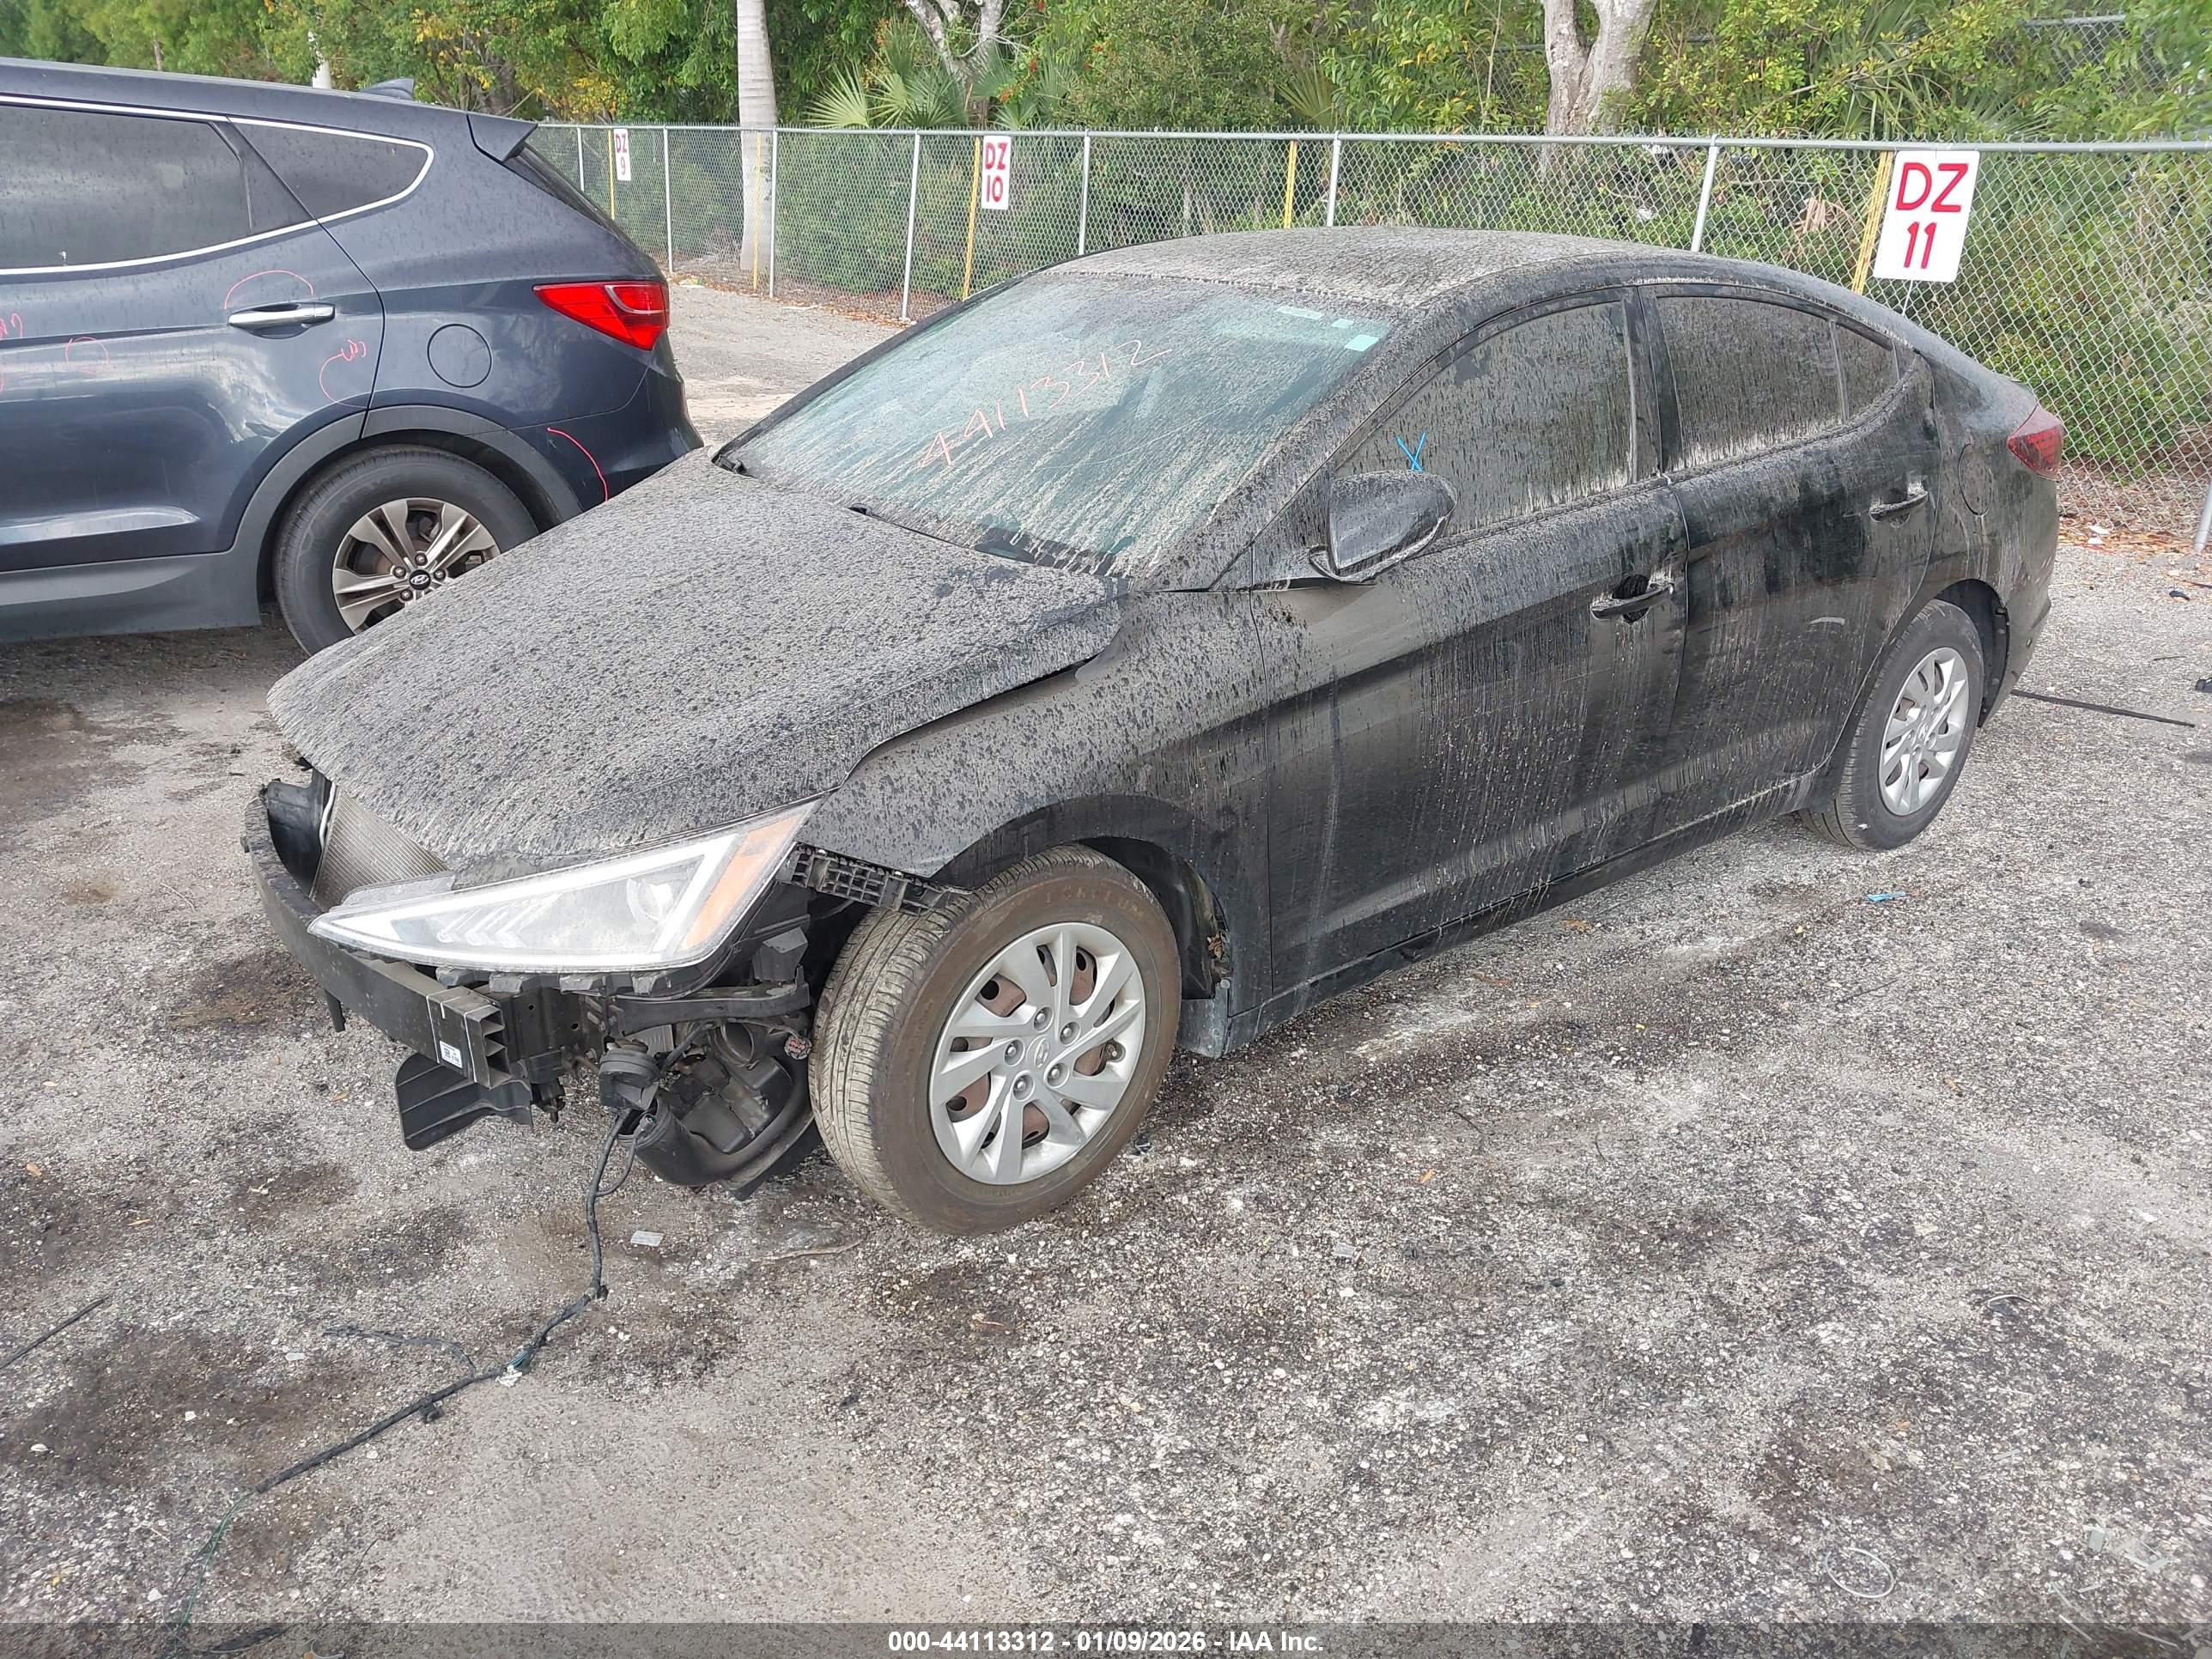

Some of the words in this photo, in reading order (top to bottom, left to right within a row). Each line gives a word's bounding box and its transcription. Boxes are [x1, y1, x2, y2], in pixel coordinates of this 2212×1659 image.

[615, 133, 628, 153] DZ
[985, 142, 1008, 170] DZ
[620, 156, 627, 176] 9
[986, 174, 1004, 203] 10
[1895, 161, 1969, 213] DZ
[1903, 221, 1937, 269] 11
[919, 340, 1173, 469] 44113312
